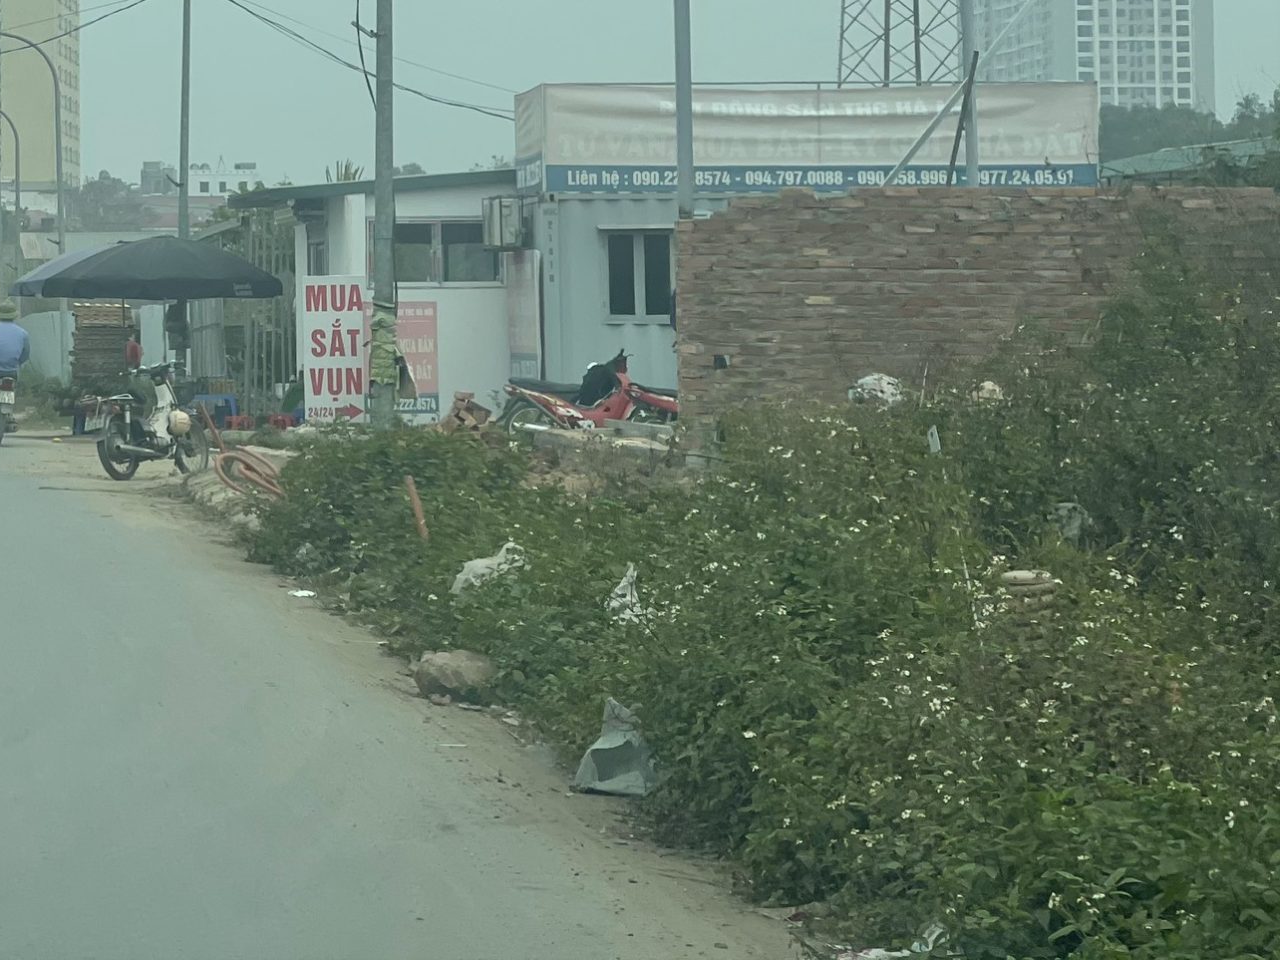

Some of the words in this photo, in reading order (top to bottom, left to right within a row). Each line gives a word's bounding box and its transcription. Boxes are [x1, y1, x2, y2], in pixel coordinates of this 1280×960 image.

[567, 170, 598, 186] Liên
[601, 170, 620, 189] hệ
[632, 170, 731, 187] 090.228574
[745, 170, 843, 186] 094.797.0088
[977, 170, 1074, 187] 977.24.05.91
[306, 284, 363, 312] MUA
[311, 318, 361, 358] SẮT
[310, 367, 363, 402] VỤN
[308, 406, 334, 419] 24/24
